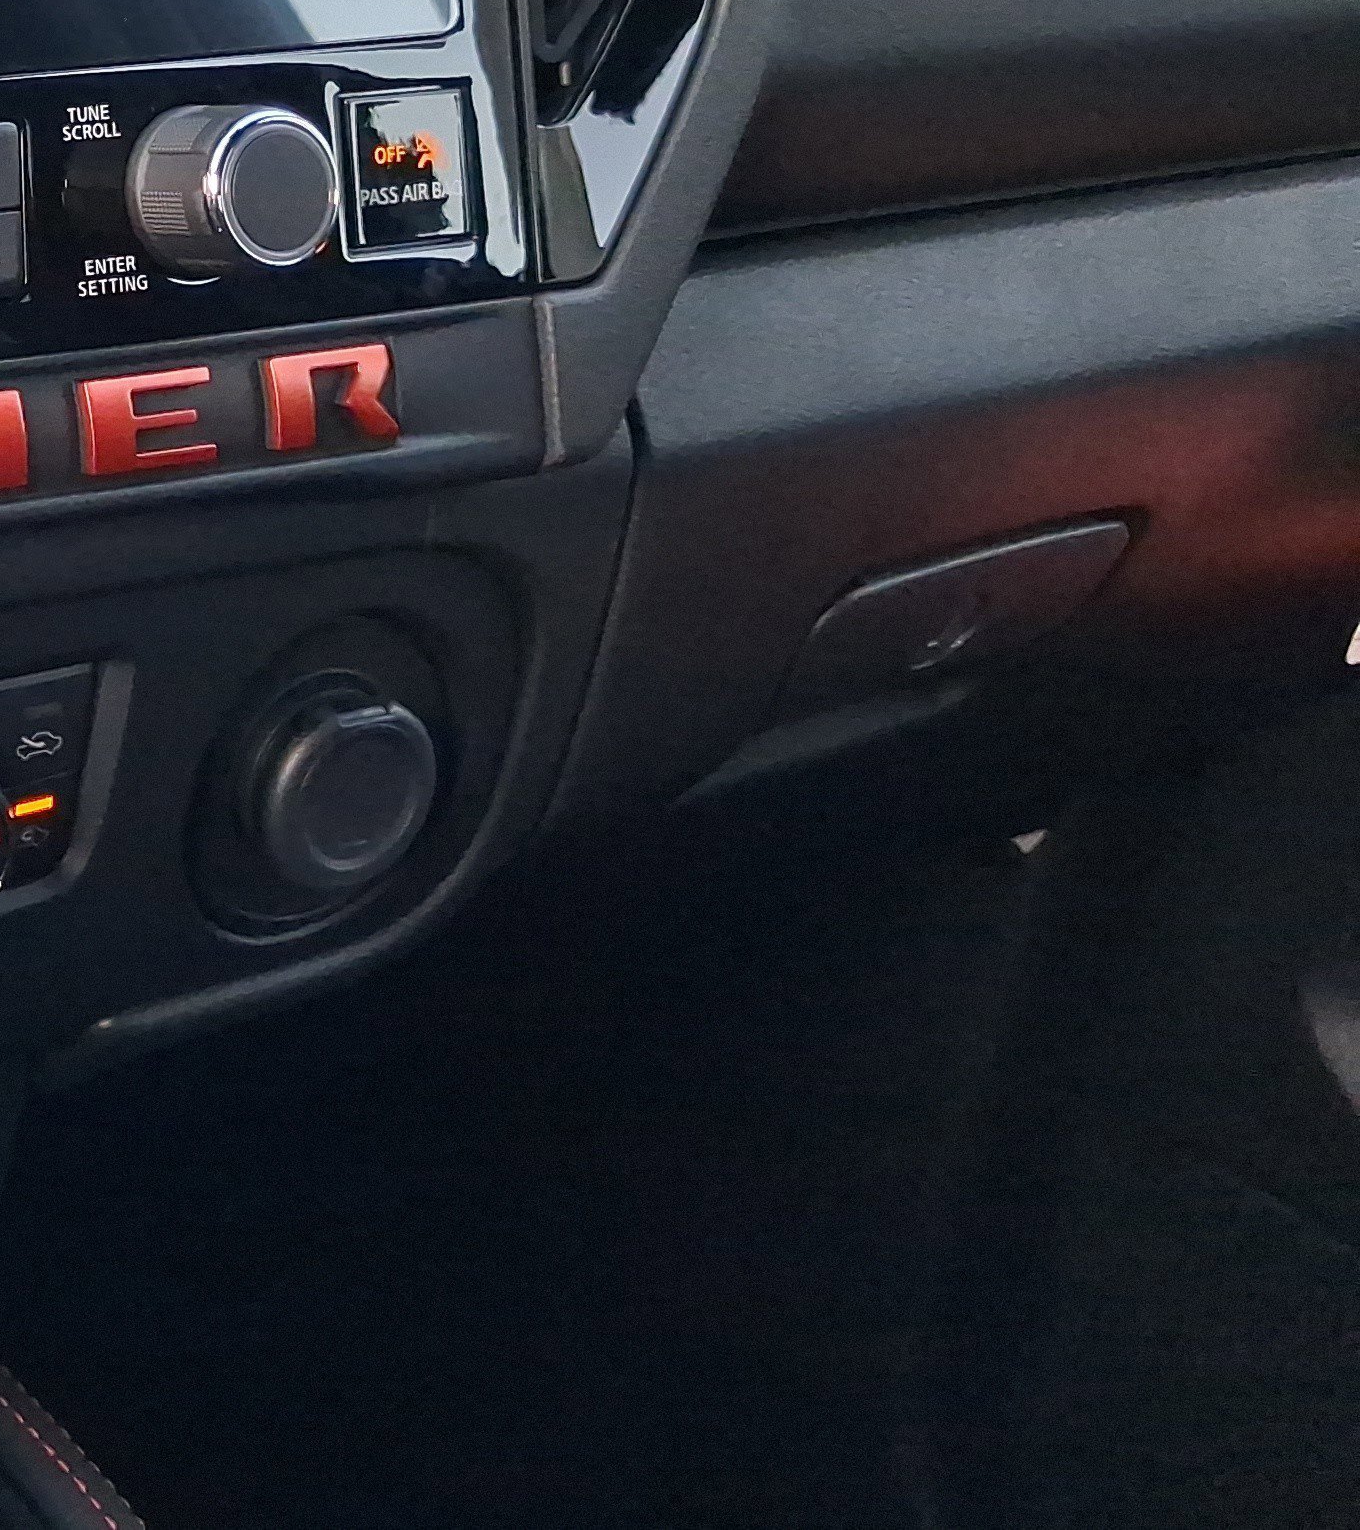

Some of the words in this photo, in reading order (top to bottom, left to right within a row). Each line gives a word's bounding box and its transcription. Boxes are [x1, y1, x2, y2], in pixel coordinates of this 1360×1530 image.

[67, 104, 111, 123] TUNE
[62, 121, 122, 142] SCROLL
[374, 146, 405, 165] OFF
[360, 187, 399, 207] PASS
[402, 182, 429, 202] AIR
[84, 255, 136, 276] ENTER
[78, 275, 149, 297] SETTING
